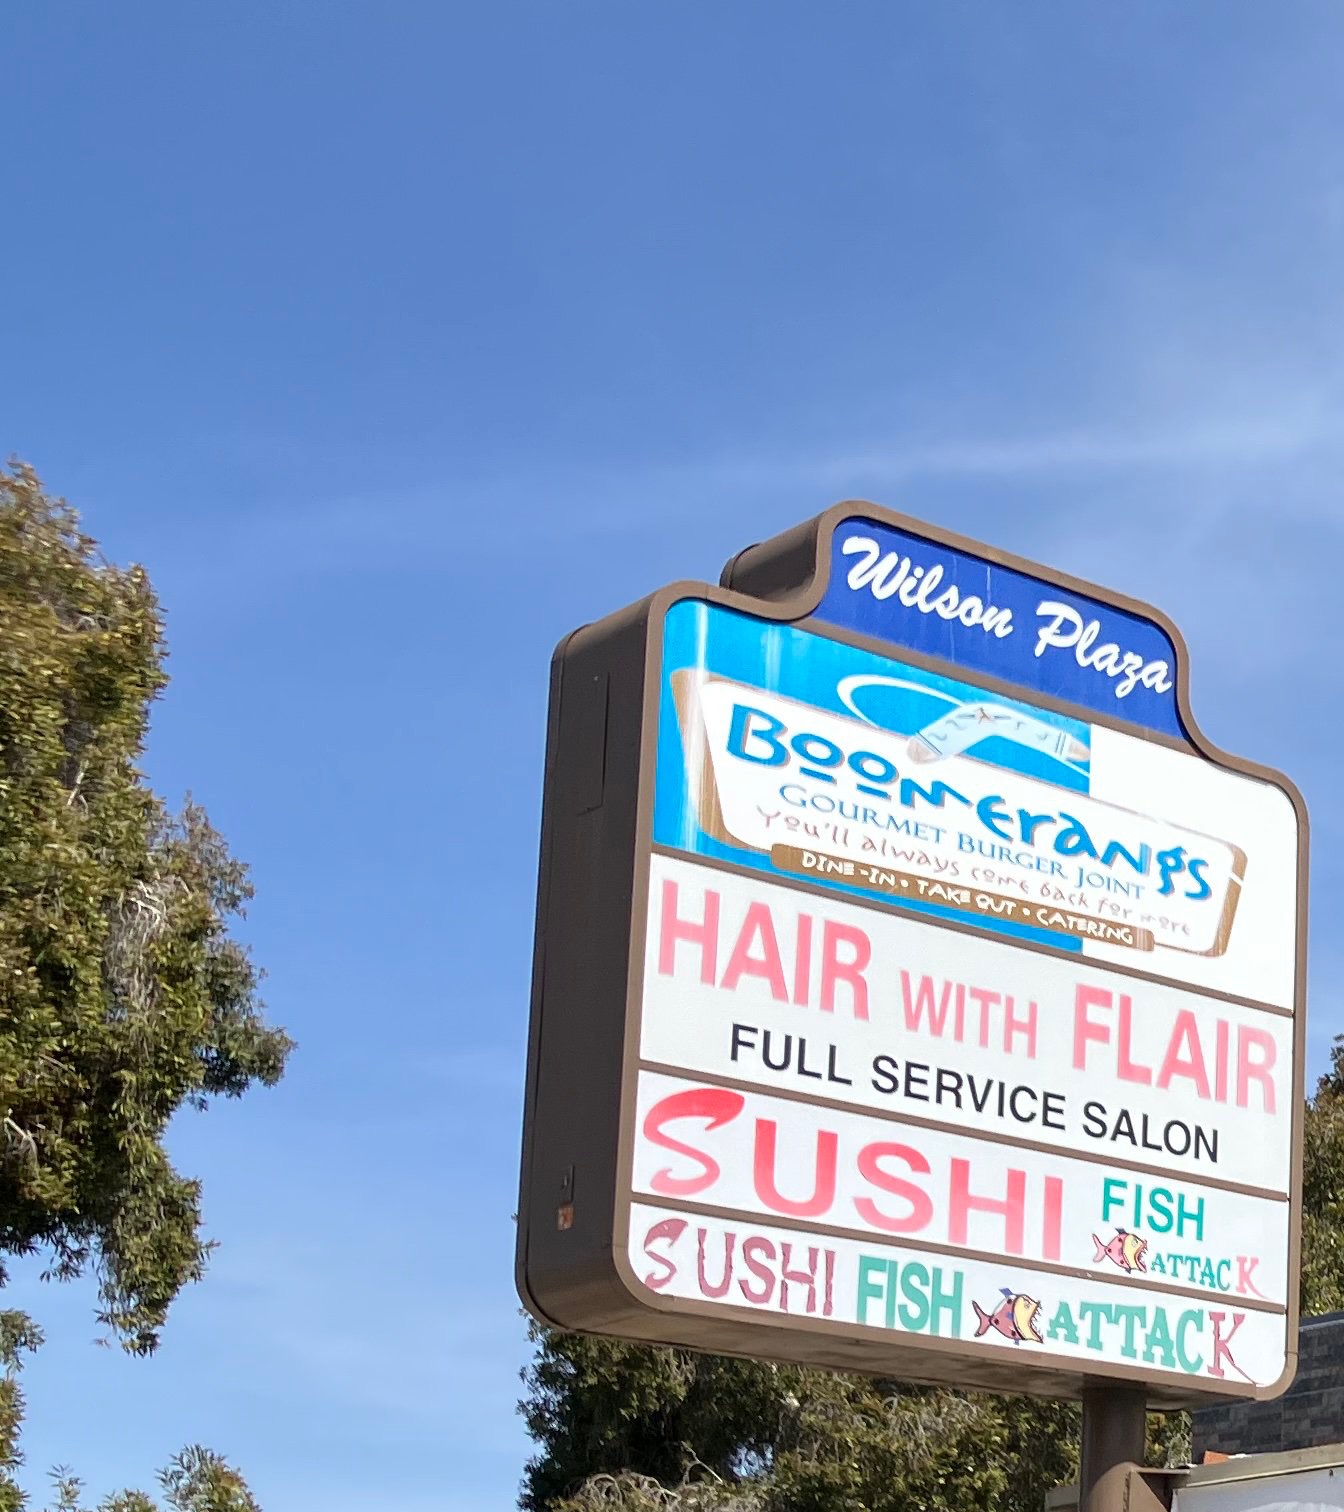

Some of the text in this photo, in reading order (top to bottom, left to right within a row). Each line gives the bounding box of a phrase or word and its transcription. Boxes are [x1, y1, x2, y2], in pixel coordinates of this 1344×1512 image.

[843, 536, 1172, 698] Wilson Plaza
[756, 804, 849, 846] You'll
[862, 835, 959, 877] always
[972, 868, 1028, 894] come
[1040, 882, 1088, 908] back
[1099, 898, 1133, 919] for
[779, 784, 1145, 899] GOURMET BURGER JOINT
[917, 879, 970, 906] TAKE
[976, 894, 1015, 916] OUT
[1036, 909, 1133, 944] CATERING
[658, 879, 1277, 1115] HAIR WITH FLAIR
[730, 1024, 1219, 1163] FULL SERVICE SALON
[643, 1087, 1205, 1261] SUSHI FISH
[643, 1217, 1257, 1384] SUSHI FISH ATTACK
[1150, 1252, 1274, 1300] ATTACK
